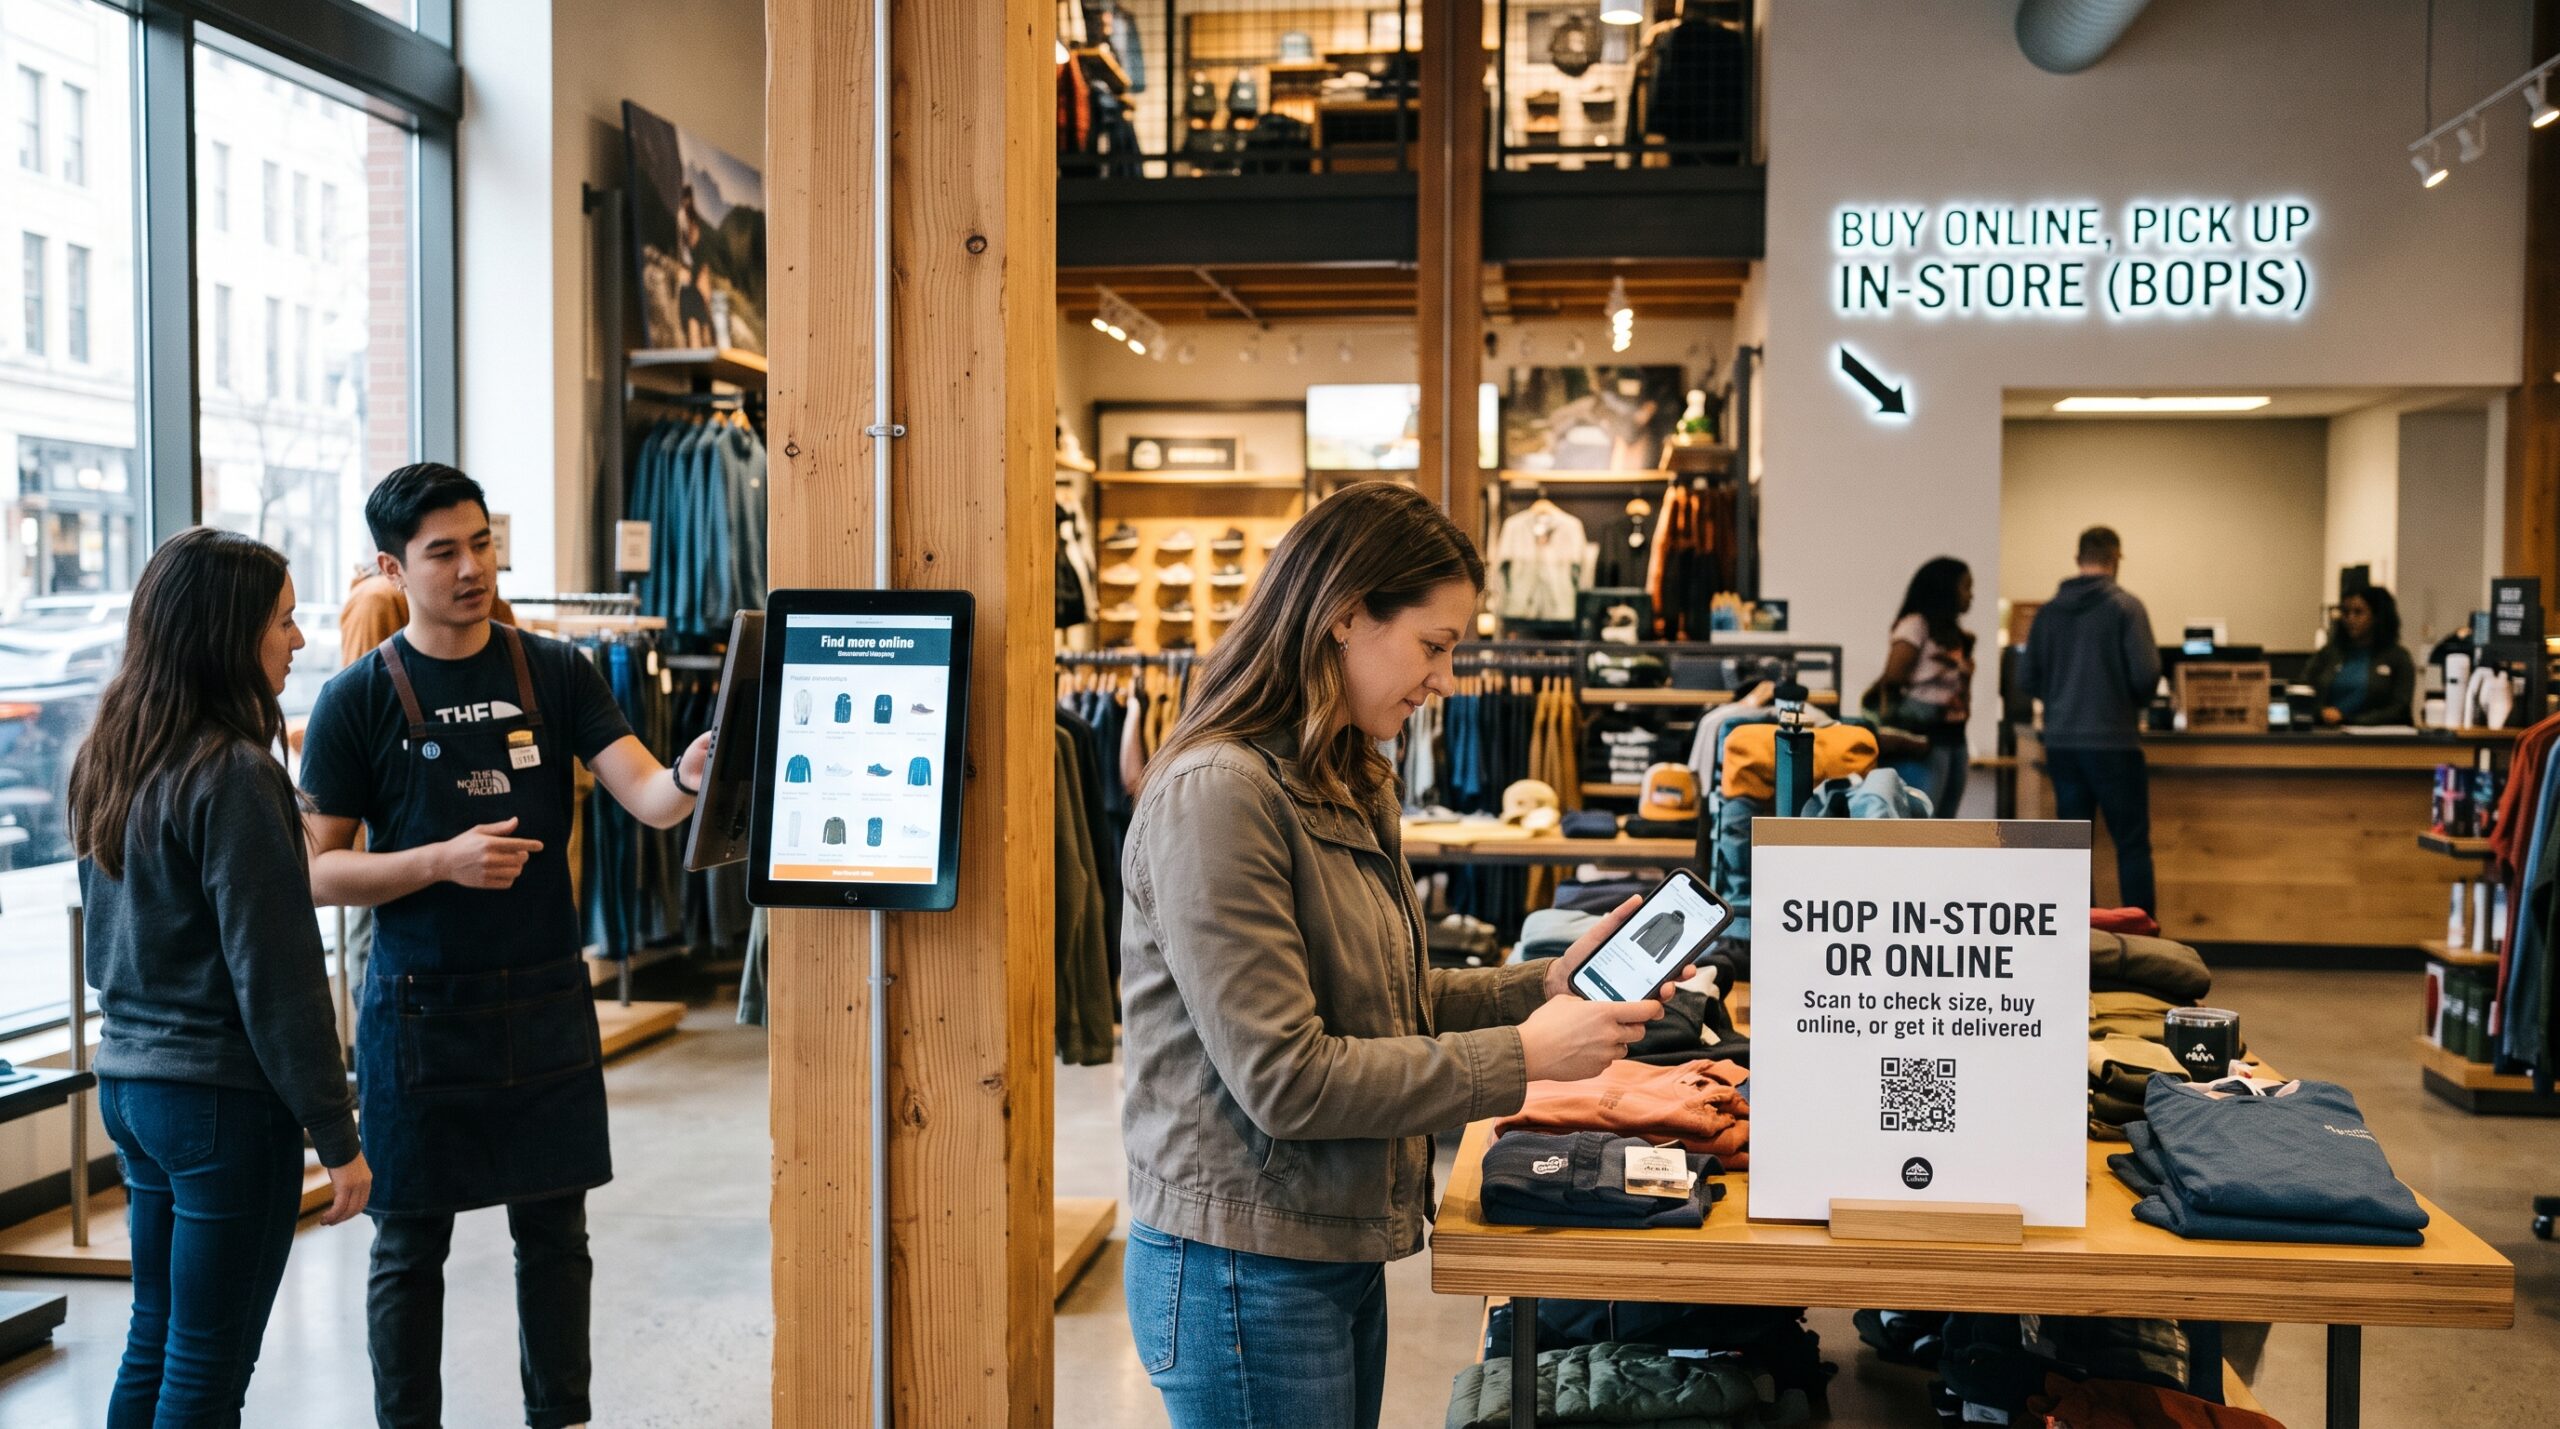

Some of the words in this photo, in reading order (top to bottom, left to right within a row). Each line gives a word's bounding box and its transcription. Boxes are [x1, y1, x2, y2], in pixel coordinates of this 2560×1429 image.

[1842, 210, 1924, 247] BUY
[1945, 208, 2112, 254] ONLINE,
[2133, 205, 2232, 244] PICK
[2253, 205, 2310, 243] UP
[1842, 262, 2084, 309] IN-STORE
[2107, 258, 2307, 313] (BOPIS)
[820, 635, 846, 648] Find
[847, 638, 876, 649] more
[878, 636, 915, 649] online
[1781, 898, 1878, 933] SHOP
[1892, 900, 2058, 936] IN-STORE
[1825, 942, 1872, 977] OR
[1885, 943, 2014, 979] ONLINE
[1803, 990, 1851, 1009] Scan
[1858, 992, 1877, 1010] to
[1883, 991, 1942, 1011] check
[1948, 993, 1993, 1015] size,
[2000, 994, 2035, 1017] buy
[1796, 1014, 1862, 1037] online,
[1868, 1020, 1889, 1035] or
[1894, 1018, 1925, 1040] get
[1932, 1016, 1945, 1036] it
[1951, 1016, 2042, 1038] delivered
